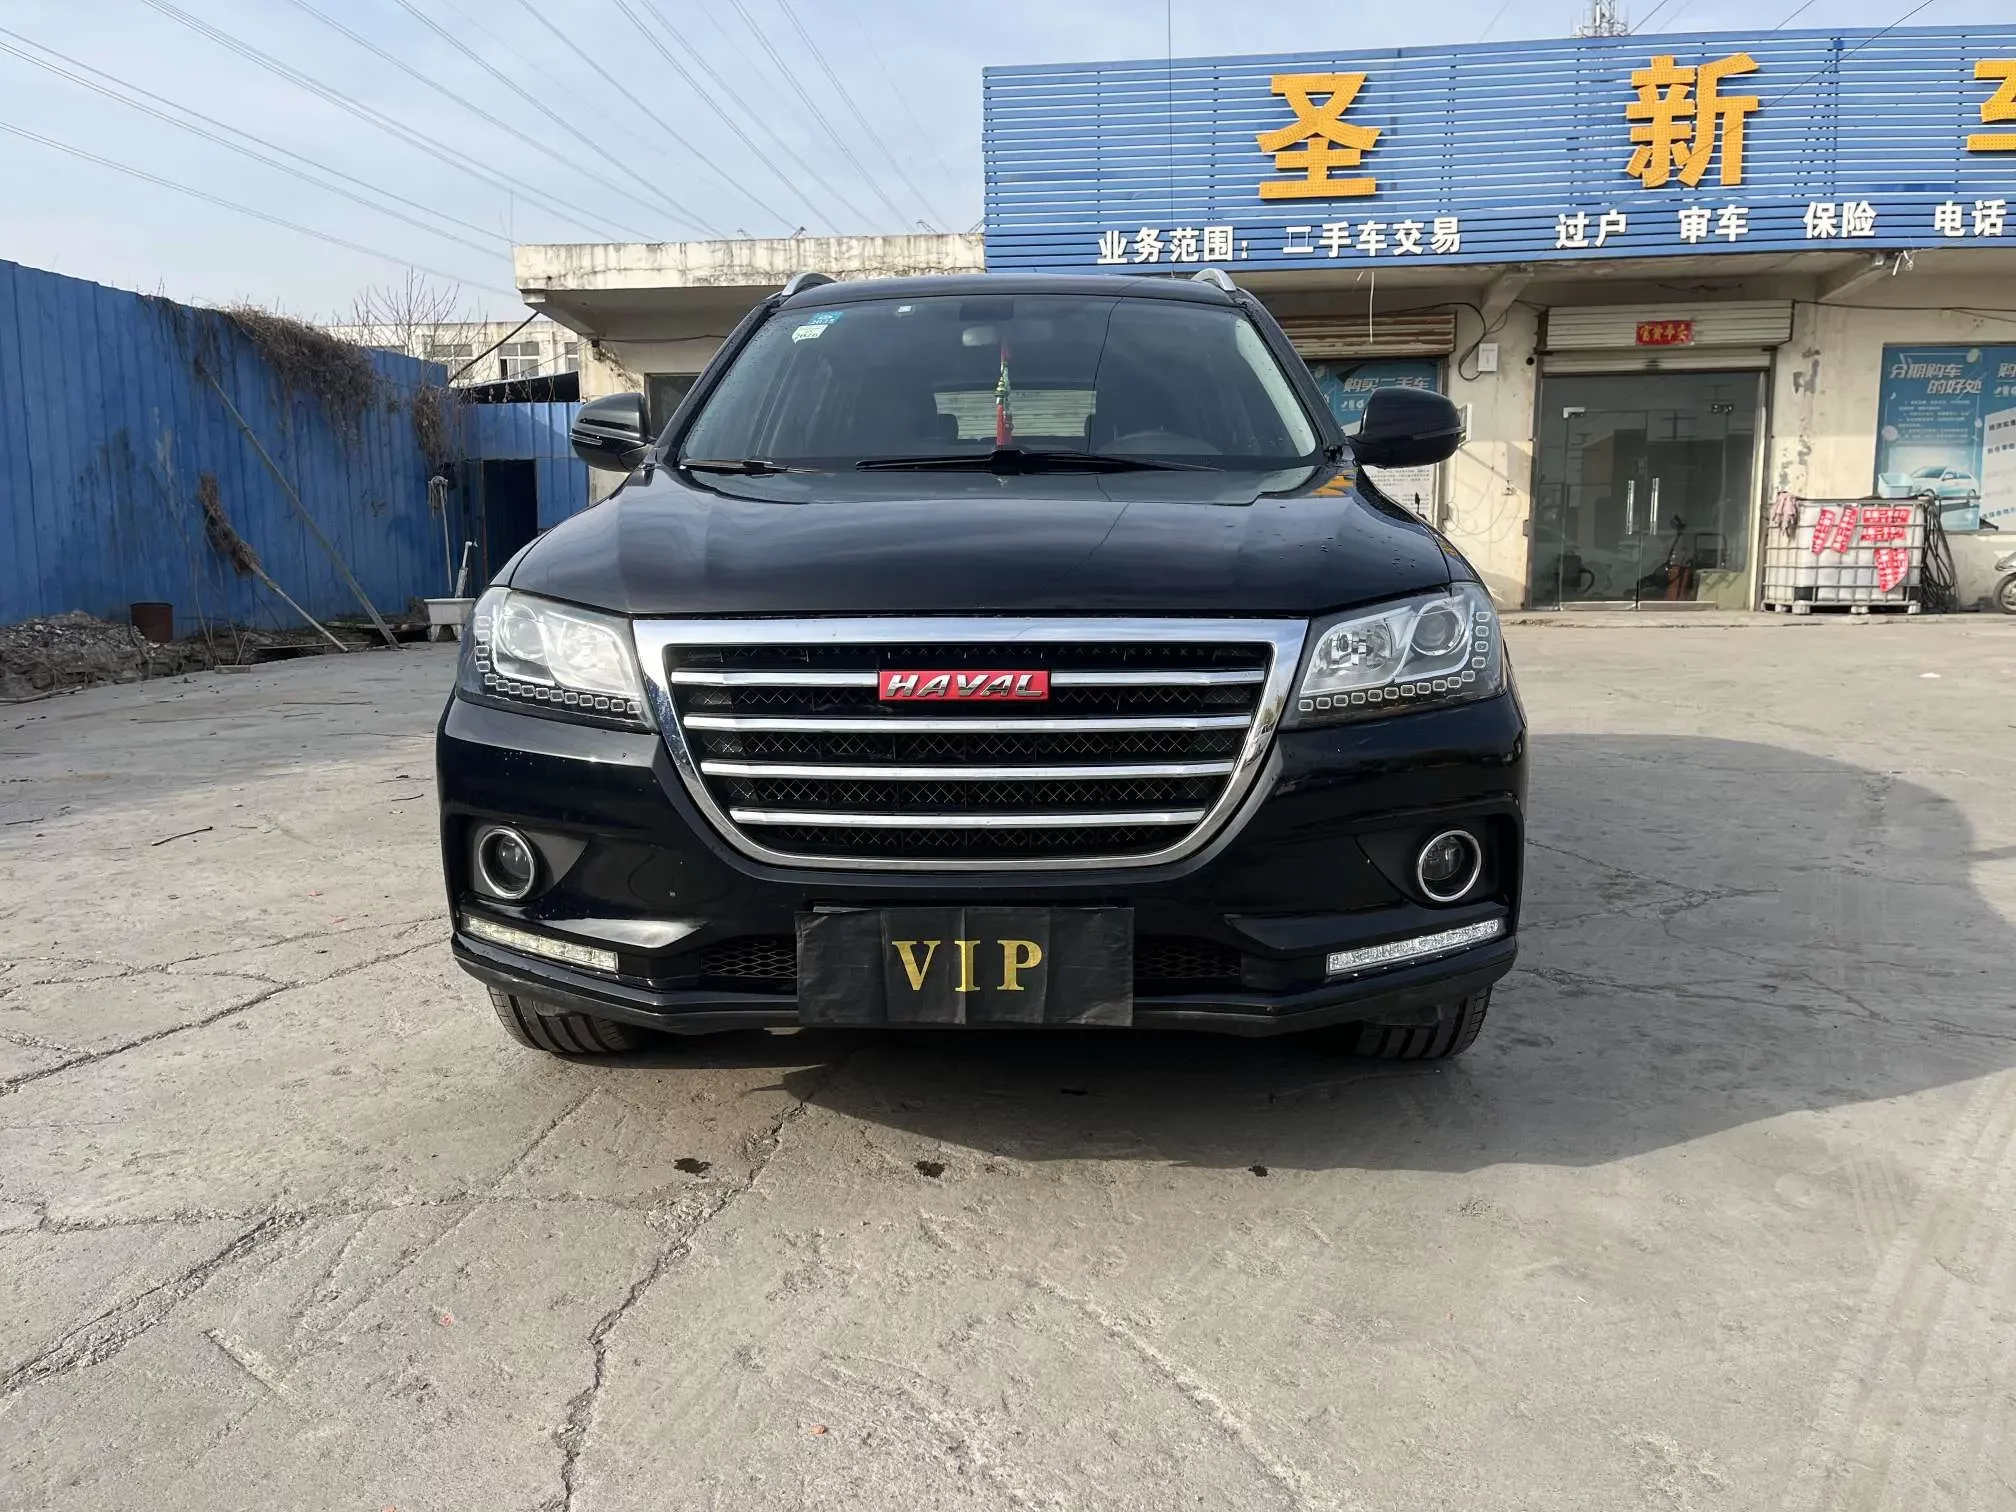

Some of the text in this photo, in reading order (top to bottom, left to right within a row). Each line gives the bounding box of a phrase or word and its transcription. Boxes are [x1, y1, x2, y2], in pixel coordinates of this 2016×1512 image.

[1255, 52, 1759, 200] 圣 新
[1283, 217, 1461, 258] 二手车交易
[1555, 209, 1628, 249] 过户
[1678, 205, 1749, 244] 审车
[1803, 201, 1877, 240] 保险
[1934, 199, 2007, 237] 电话
[1889, 363, 1964, 379] 分期购车
[1927, 379, 1982, 394] 的好处
[886, 674, 1043, 697] HAVAL
[891, 940, 1042, 992] VIP
